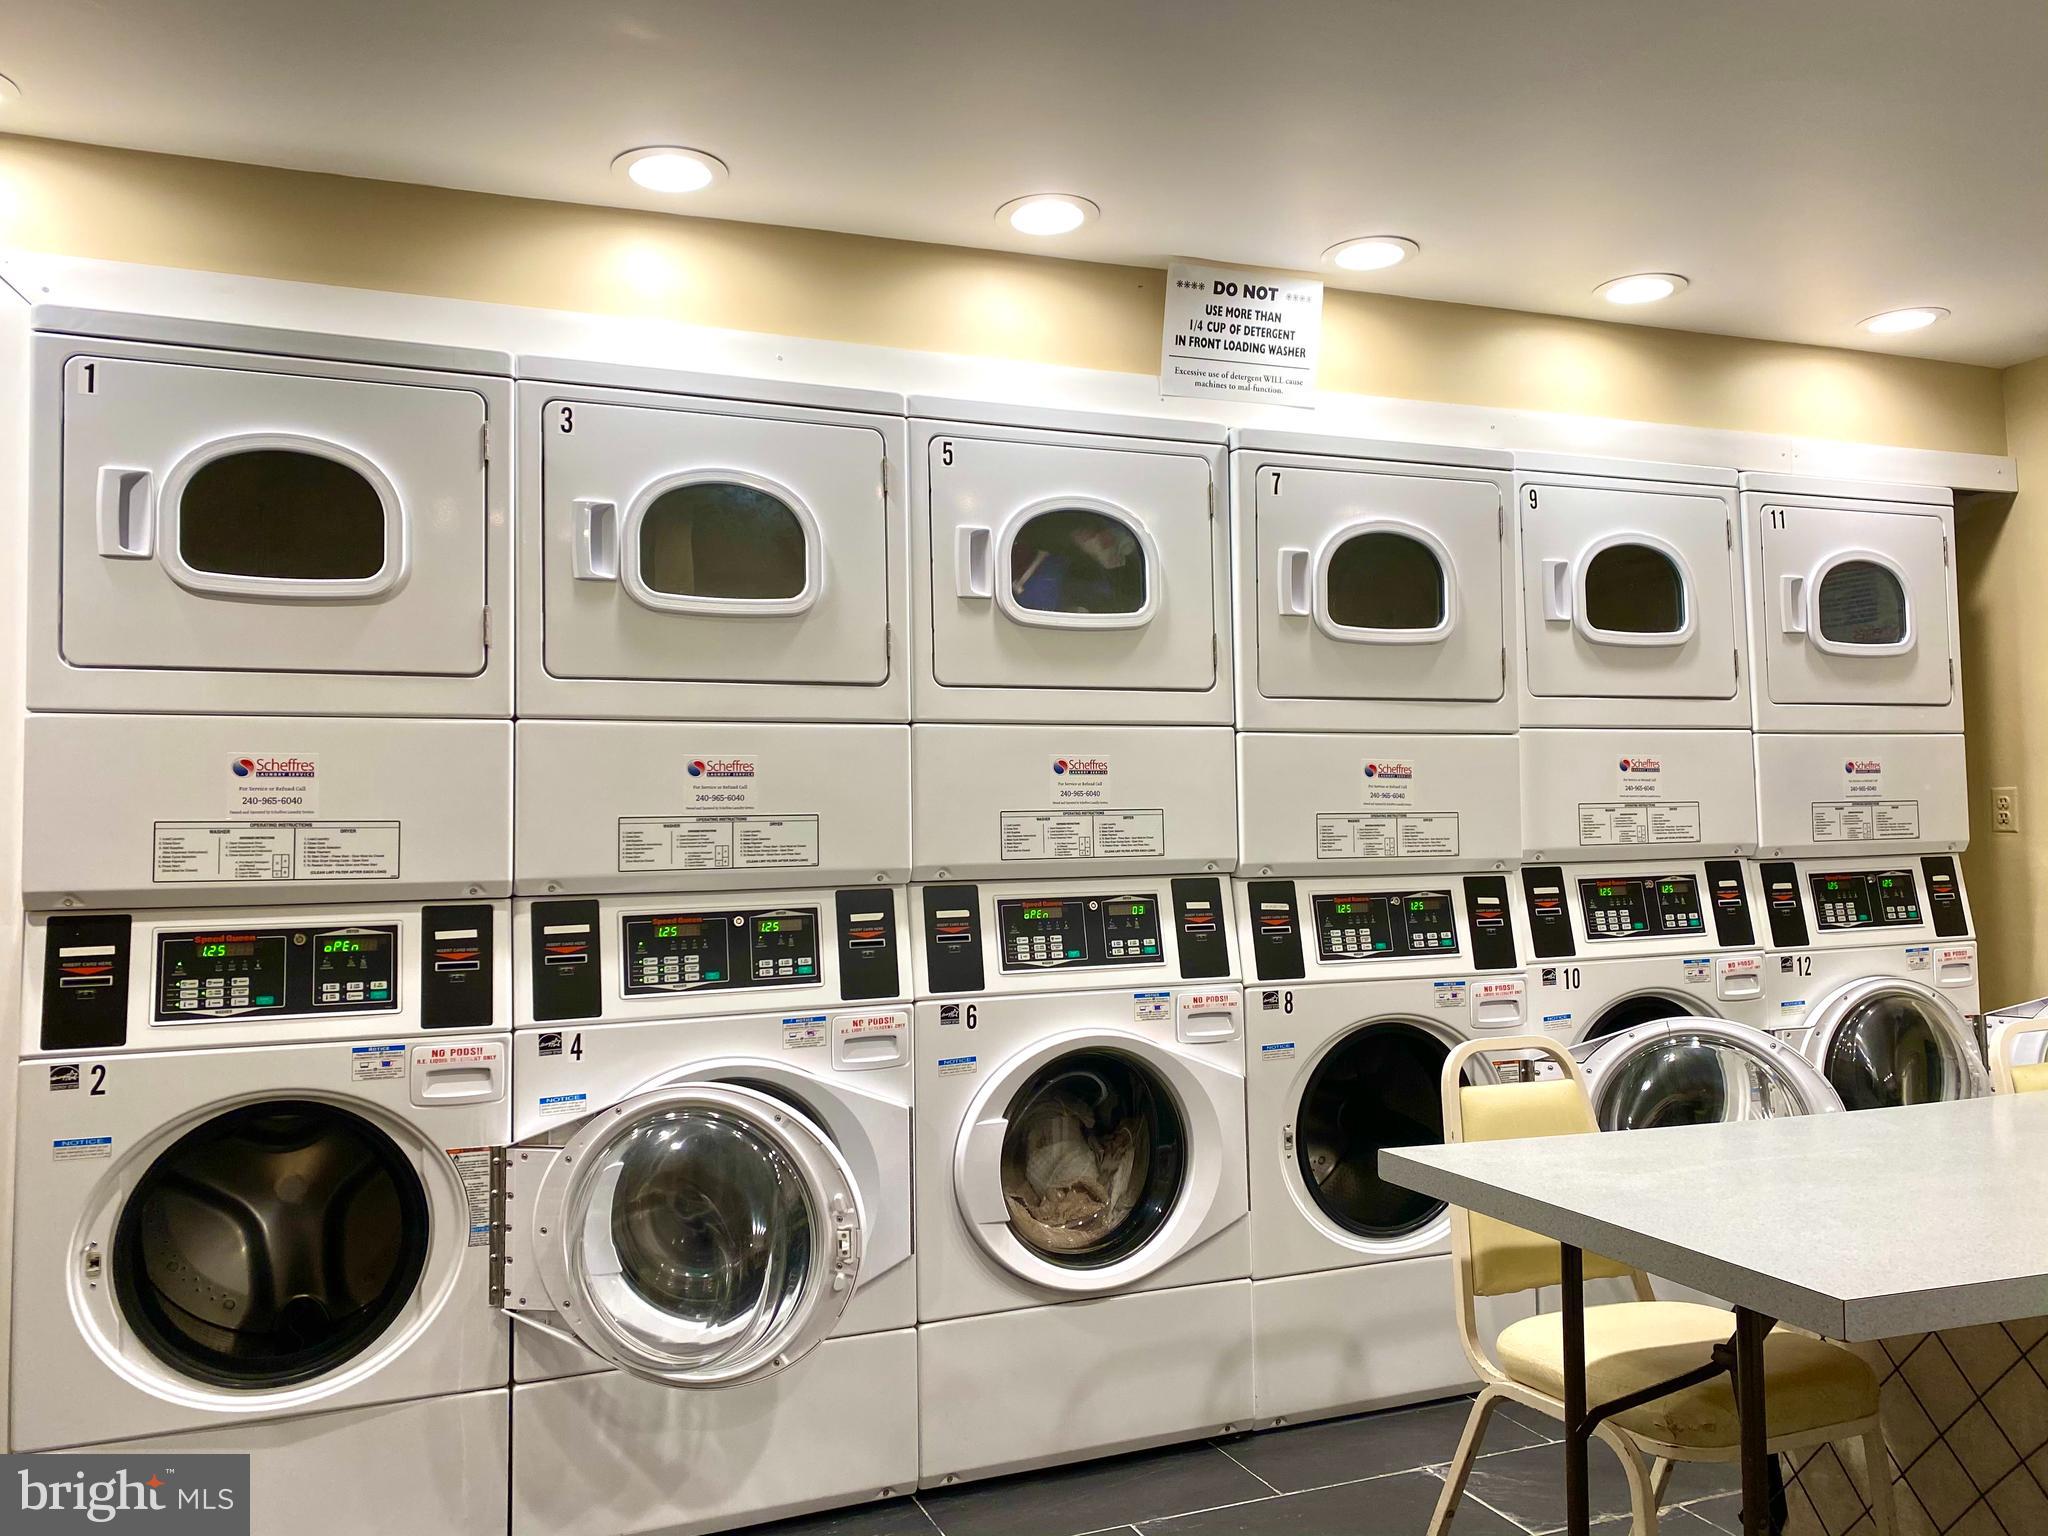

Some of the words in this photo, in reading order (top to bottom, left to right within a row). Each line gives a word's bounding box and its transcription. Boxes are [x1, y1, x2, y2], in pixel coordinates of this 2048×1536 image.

[1213, 280, 1237, 296] DO
[1243, 284, 1279, 301] NOT
[1206, 304, 1223, 316] USE
[1225, 306, 1252, 320] MORE
[1255, 310, 1282, 323] THAN
[1190, 319, 1203, 332] 1/4
[1207, 321, 1226, 334] CUP
[1230, 323, 1242, 335] OF
[1244, 326, 1296, 341] DETERGENT
[1175, 334, 1186, 346] IN
[1188, 336, 1222, 350] FRONT
[1224, 339, 1266, 354] LOADING
[1268, 344, 1306, 358] WASHER
[84, 364, 94, 394] 1
[1174, 366, 1207, 377] Excessive
[1208, 371, 1220, 379] use
[1221, 371, 1230, 379] of
[1230, 372, 1262, 383] detergent
[1264, 375, 1283, 384] WILL
[1285, 378, 1304, 386] cause
[1194, 380, 1227, 389] machines
[560, 406, 572, 434] 3
[942, 442, 953, 466] 5
[1272, 472, 1281, 495] 7
[1530, 489, 1537, 509] 9
[1771, 510, 1785, 529] 11
[256, 758, 314, 771] Scheffres
[706, 760, 754, 772] Scheffres
[1068, 759, 1108, 771] Scheffres
[1378, 764, 1412, 774] Scheffres
[1132, 906, 1144, 915] 03
[1797, 956, 1812, 976] 12
[1564, 968, 1580, 989] 10
[1285, 991, 1293, 1014] 8
[868, 1017, 894, 1026] PODS!!
[967, 1005, 976, 1029] 6
[450, 1047, 483, 1056] PODS!!
[570, 1033, 582, 1060] 4
[90, 1064, 106, 1095] 2
